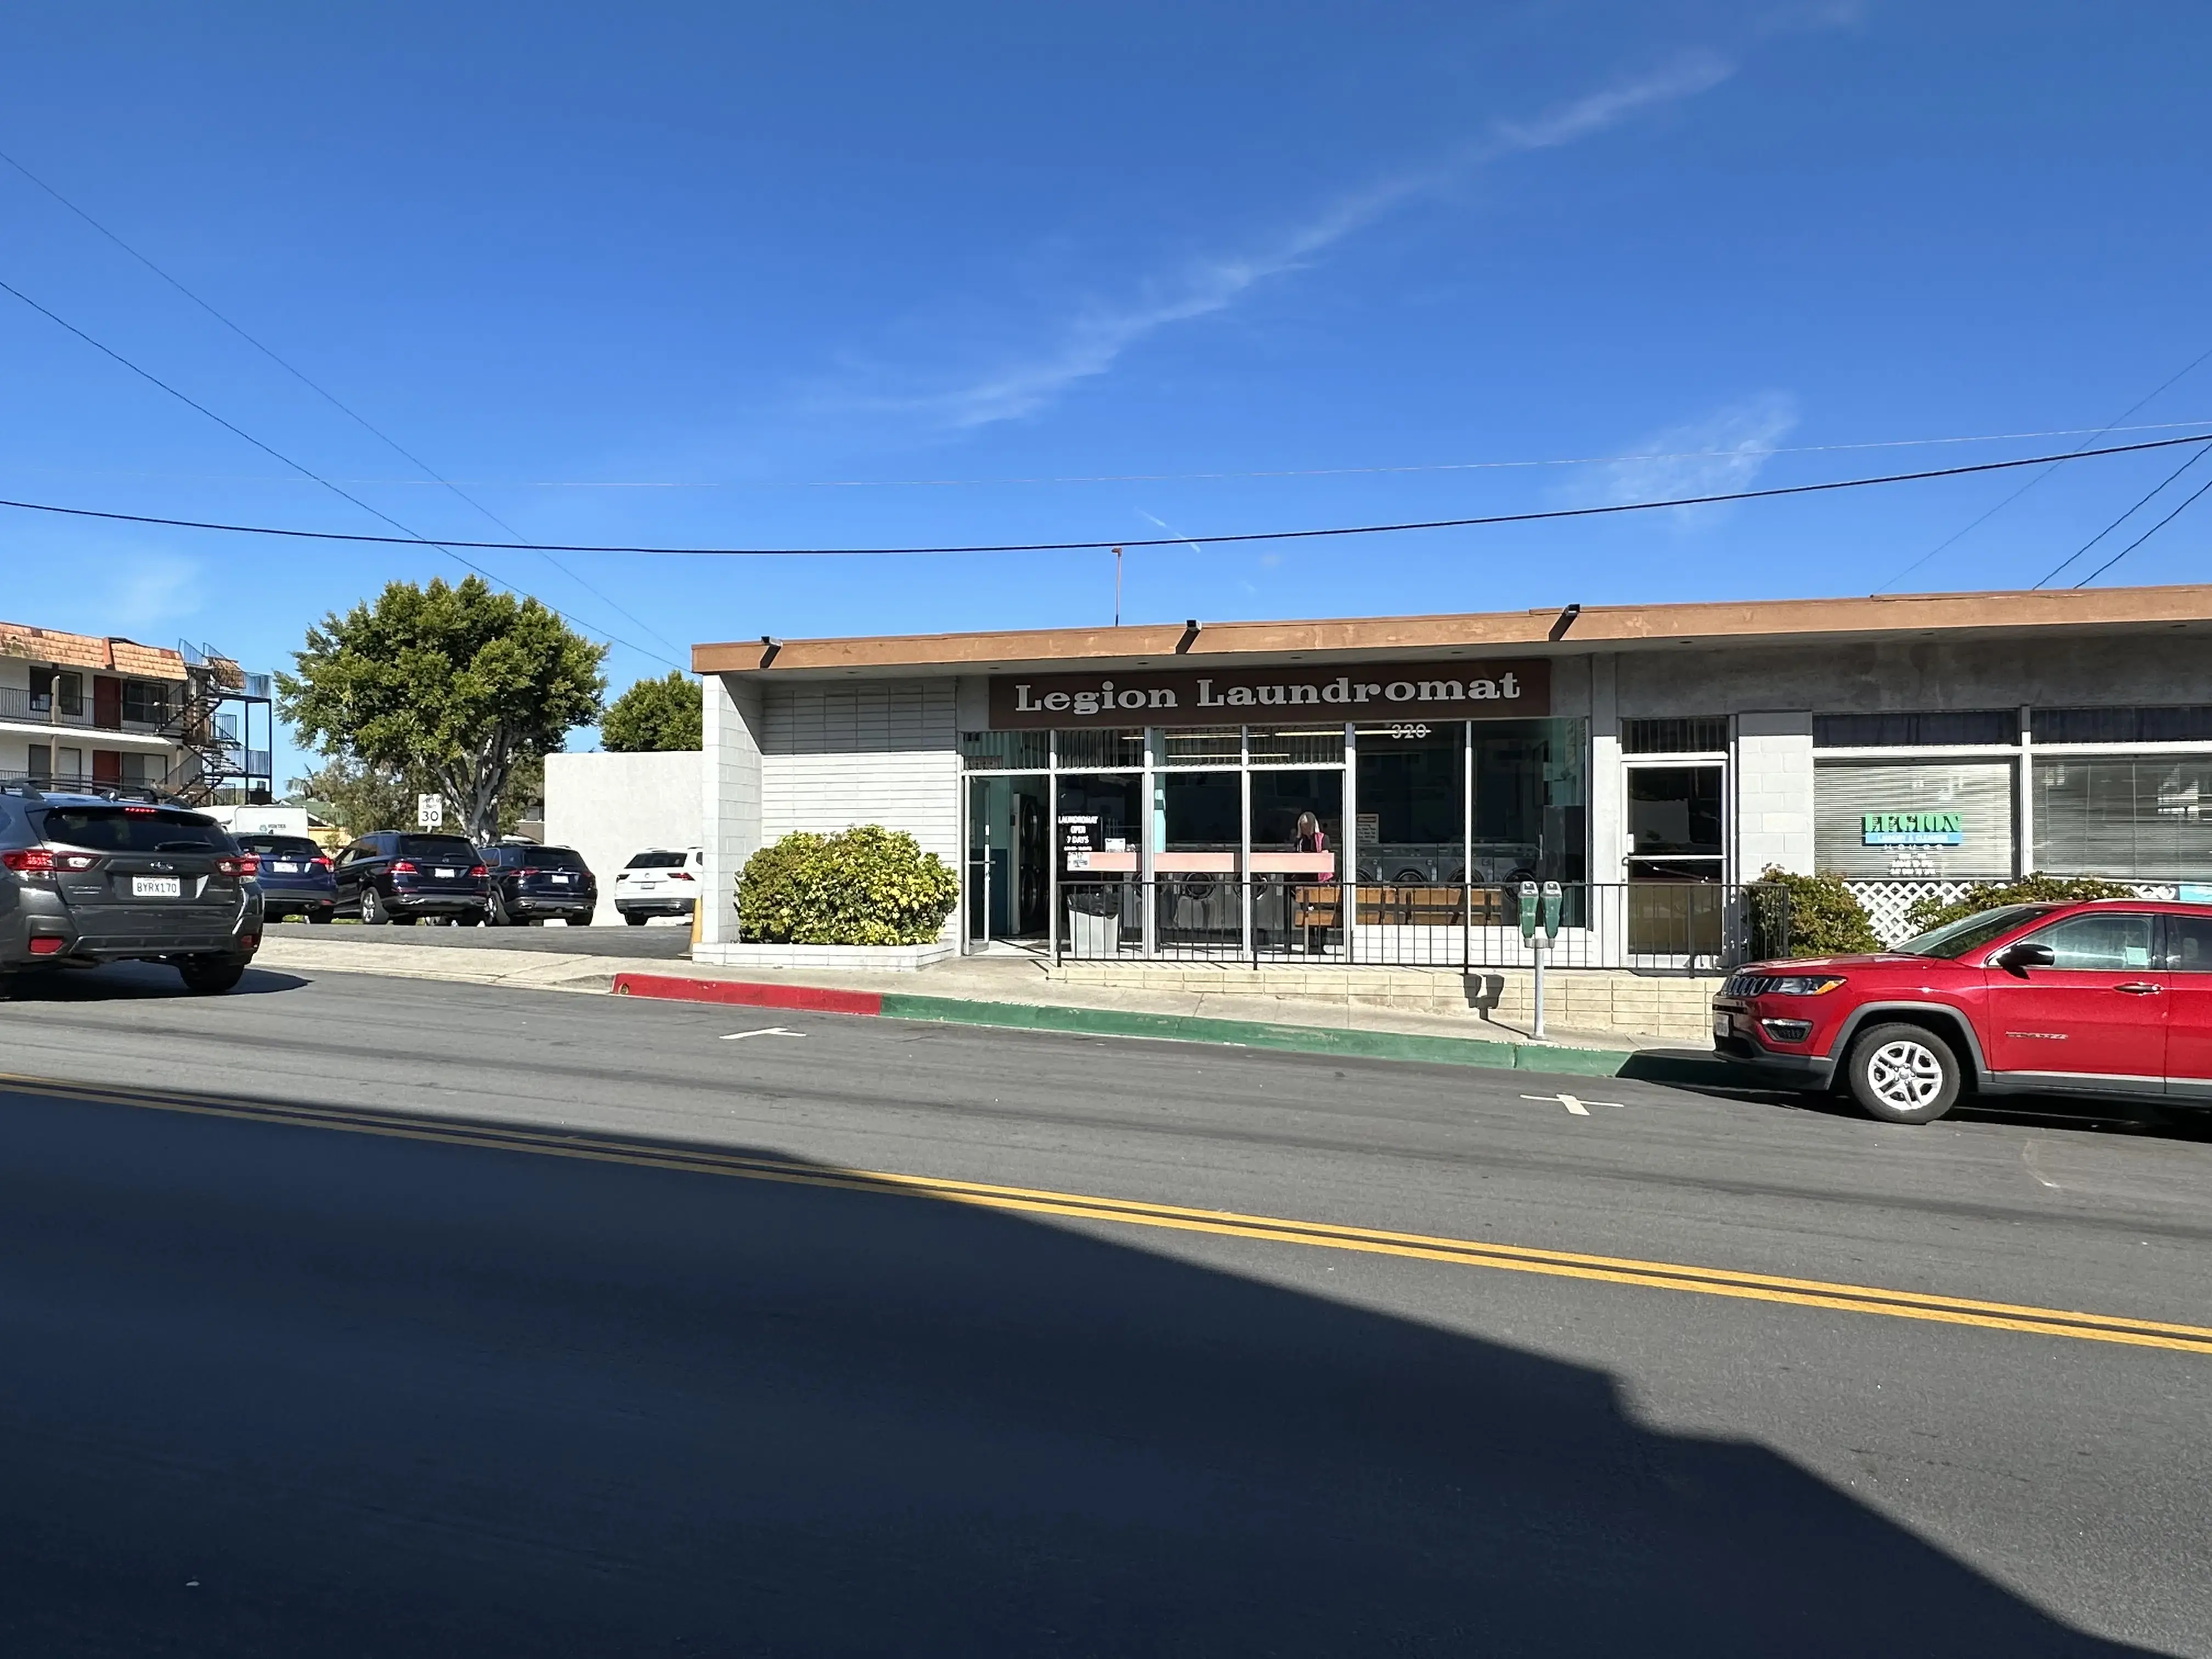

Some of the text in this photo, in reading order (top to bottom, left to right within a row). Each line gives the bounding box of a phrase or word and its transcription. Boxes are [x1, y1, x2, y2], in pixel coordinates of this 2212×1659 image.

[1015, 672, 1521, 714] Legion Laundromat
[1392, 724, 1426, 738] 320
[422, 811, 438, 822] 30
[1865, 812, 1962, 832] LEGION
[1071, 825, 1086, 834] OPEN
[1072, 836, 1090, 844] DAYS
[137, 882, 177, 893] 8YRX170
